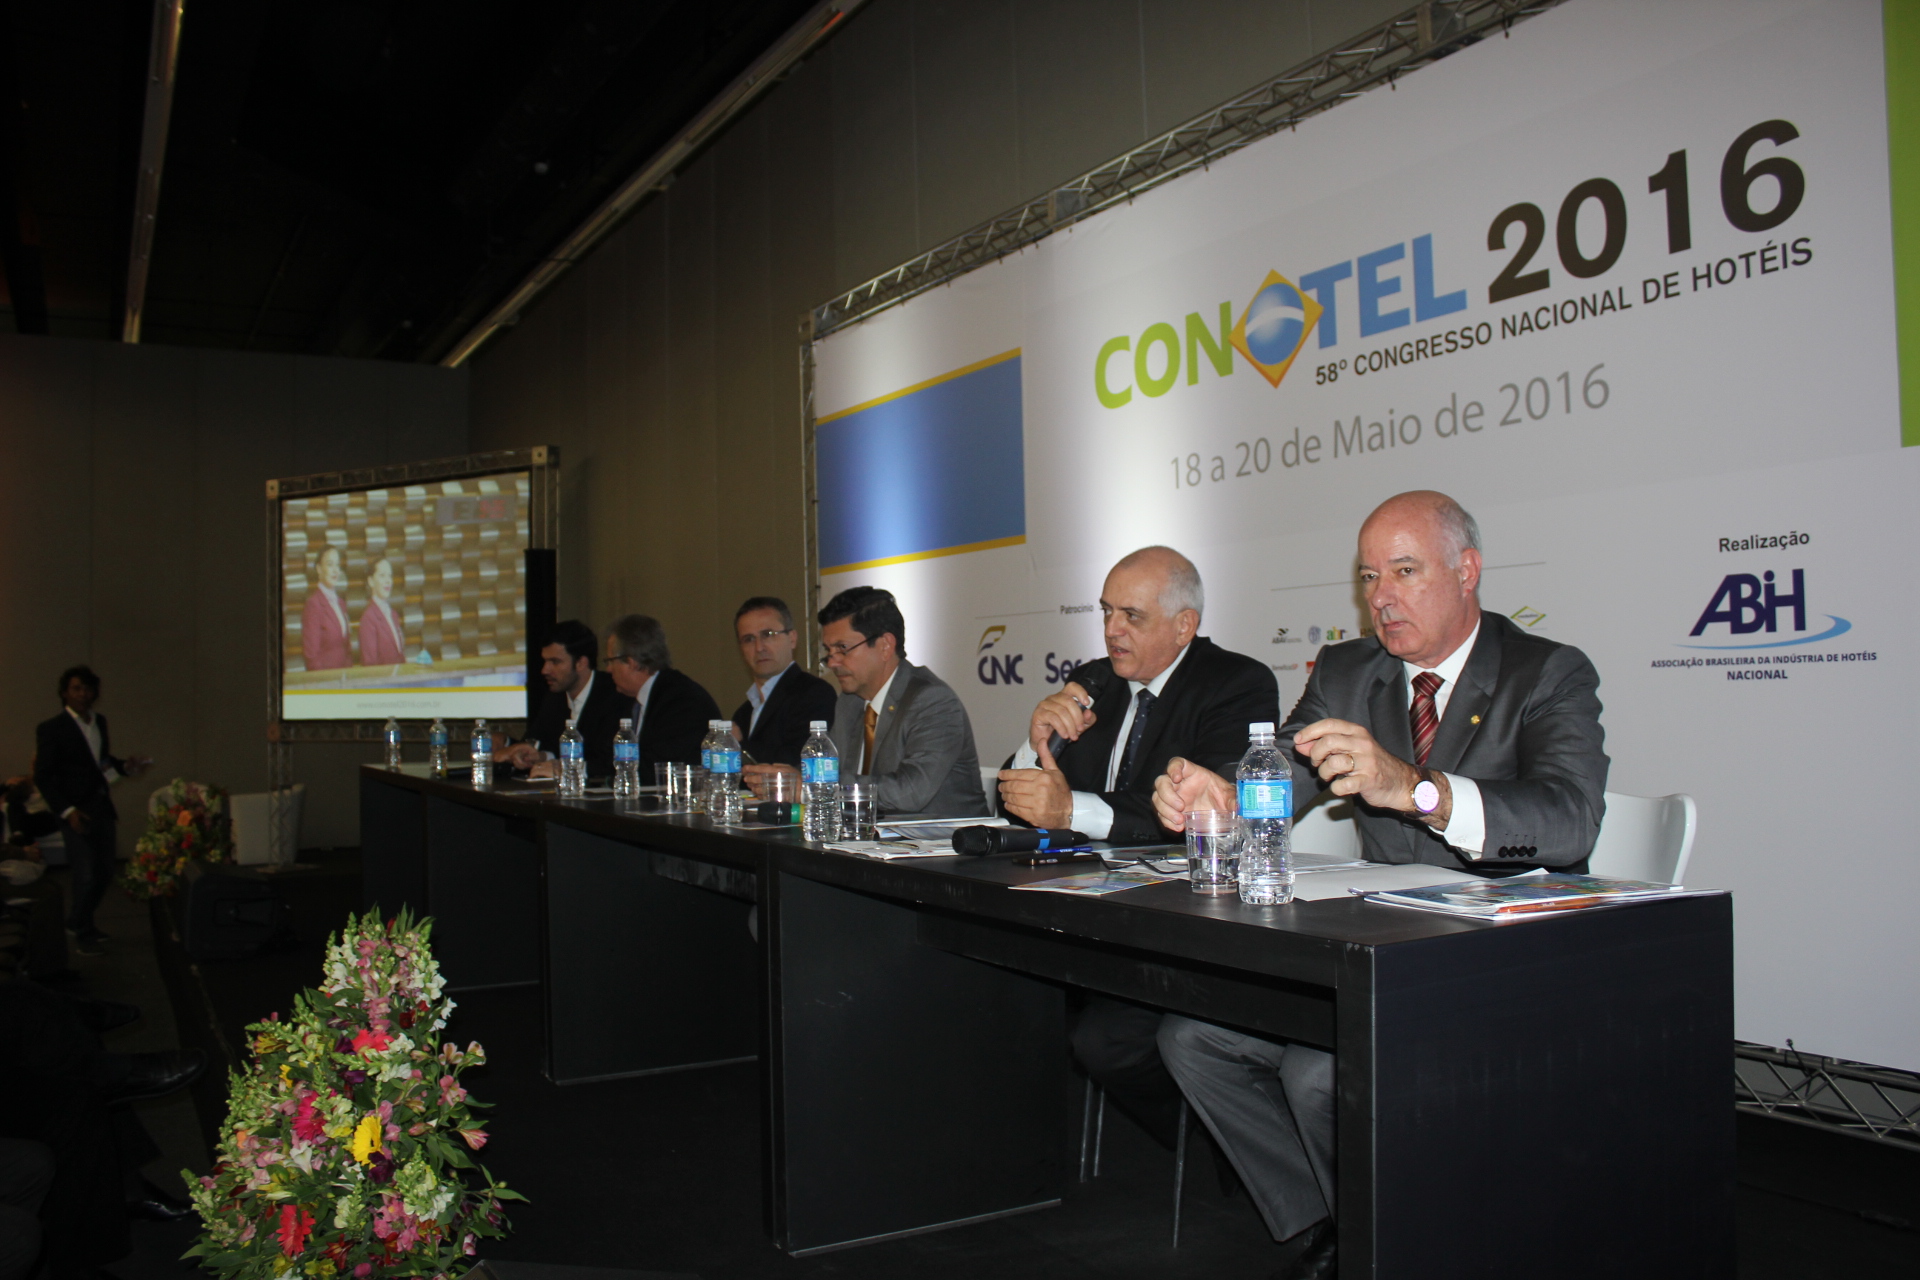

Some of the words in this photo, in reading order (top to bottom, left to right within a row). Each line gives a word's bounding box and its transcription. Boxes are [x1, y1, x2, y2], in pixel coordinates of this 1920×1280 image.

[1487, 119, 1806, 304] 2016
[1353, 322, 1493, 377] CONGRESSO
[1500, 285, 1633, 341] NACIONAL
[1641, 270, 1682, 305] DE
[1691, 236, 1814, 293] HOTÉIS
[1170, 452, 1202, 490] 18
[1210, 455, 1227, 483] a
[1235, 437, 1272, 478] 20
[1281, 427, 1322, 469] de
[1333, 408, 1422, 459] Maio
[1434, 391, 1485, 438] de
[1498, 363, 1610, 428] 2016
[1718, 531, 1810, 553] Realização
[978, 654, 1024, 686] CNC
[1651, 655, 1704, 669] ASSOCIAÇÃO
[1705, 656, 1755, 667] BRASILEIRA
[1757, 655, 1771, 665] DA
[1772, 653, 1824, 664] INDÚSTRIA
[1826, 652, 1839, 663] DE
[1841, 650, 1878, 662] HOTÉIS
[1726, 669, 1788, 681] NACIONAL
